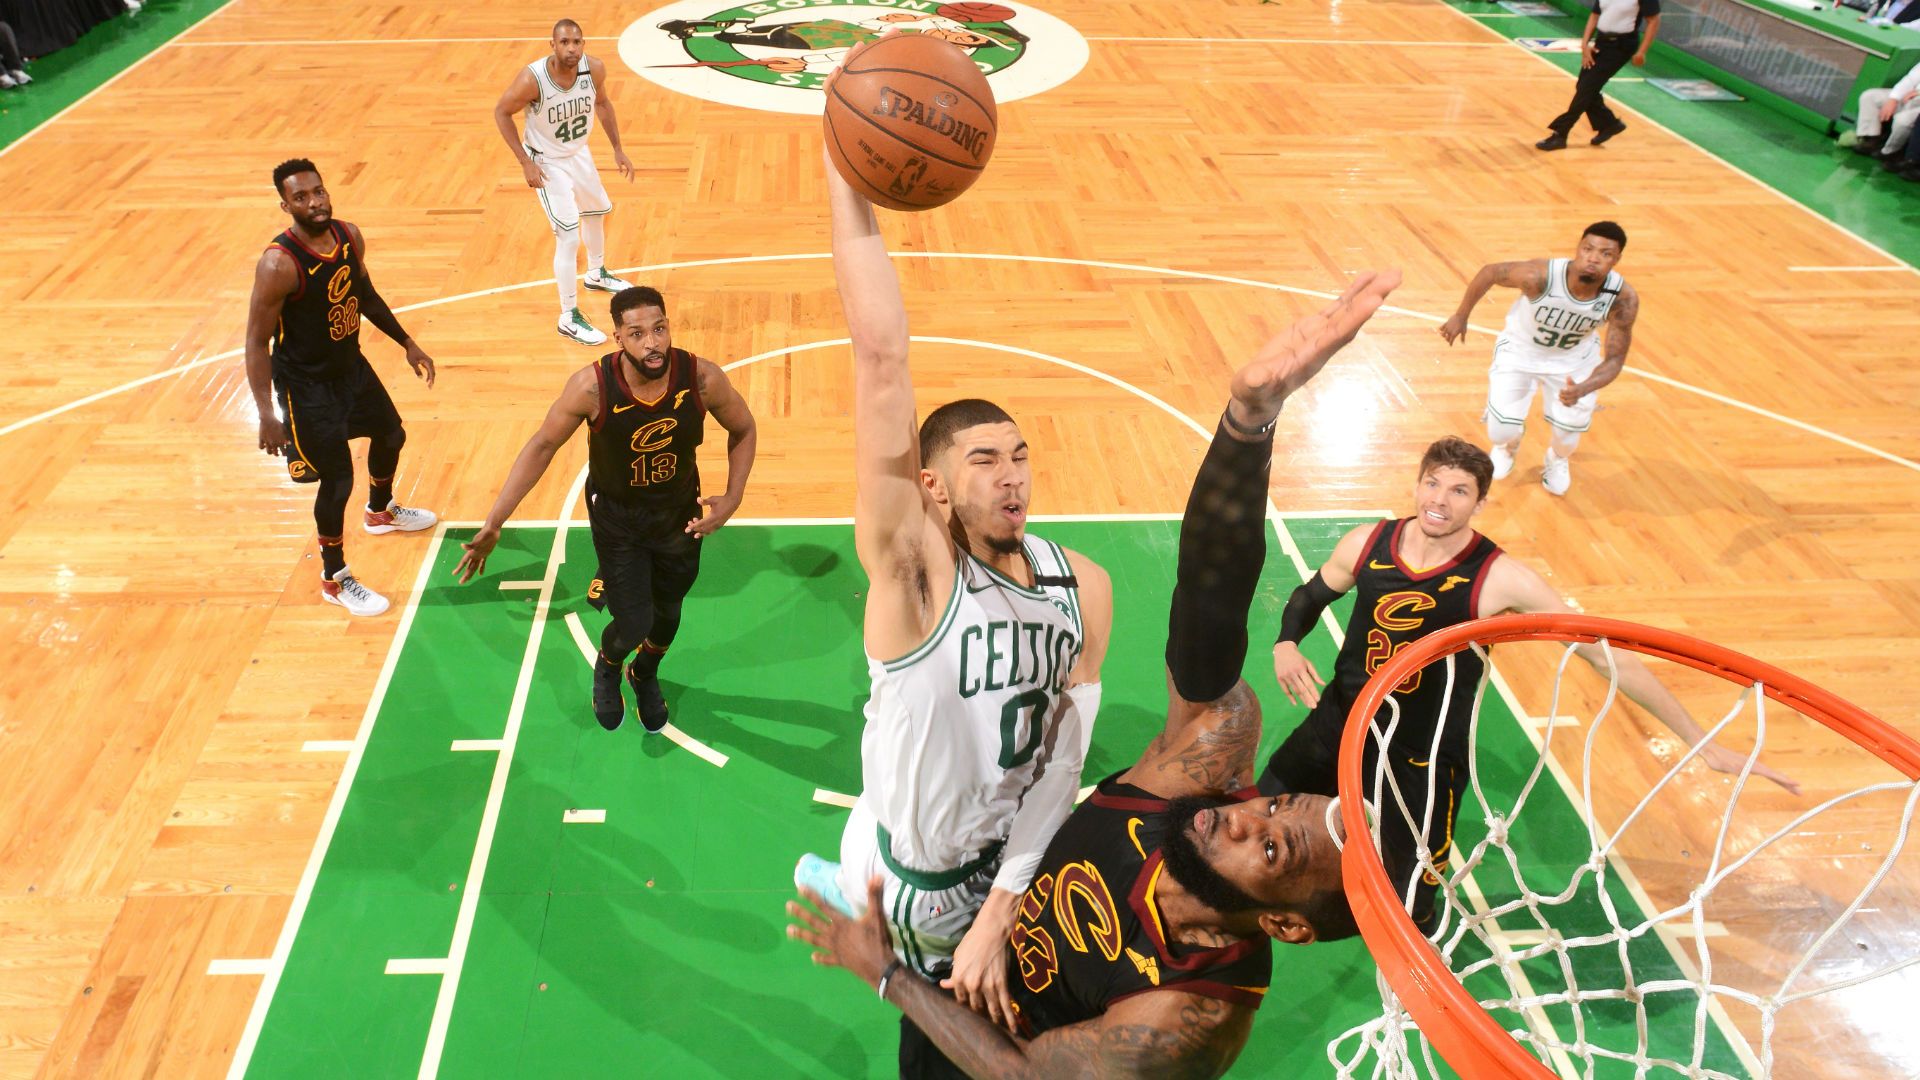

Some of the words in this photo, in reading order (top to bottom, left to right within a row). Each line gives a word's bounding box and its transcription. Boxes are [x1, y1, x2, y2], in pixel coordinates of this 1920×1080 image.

[548, 96, 591, 124] CELTICS
[555, 115, 587, 143] 42
[873, 86, 988, 161] SPALDING
[328, 265, 351, 303] C
[328, 296, 359, 341] 32
[1533, 326, 1585, 350] 36
[631, 418, 677, 452] C
[631, 453, 677, 486] 13
[1374, 591, 1436, 631] C
[998, 688, 1049, 769] 0
[1054, 860, 1122, 961] C
